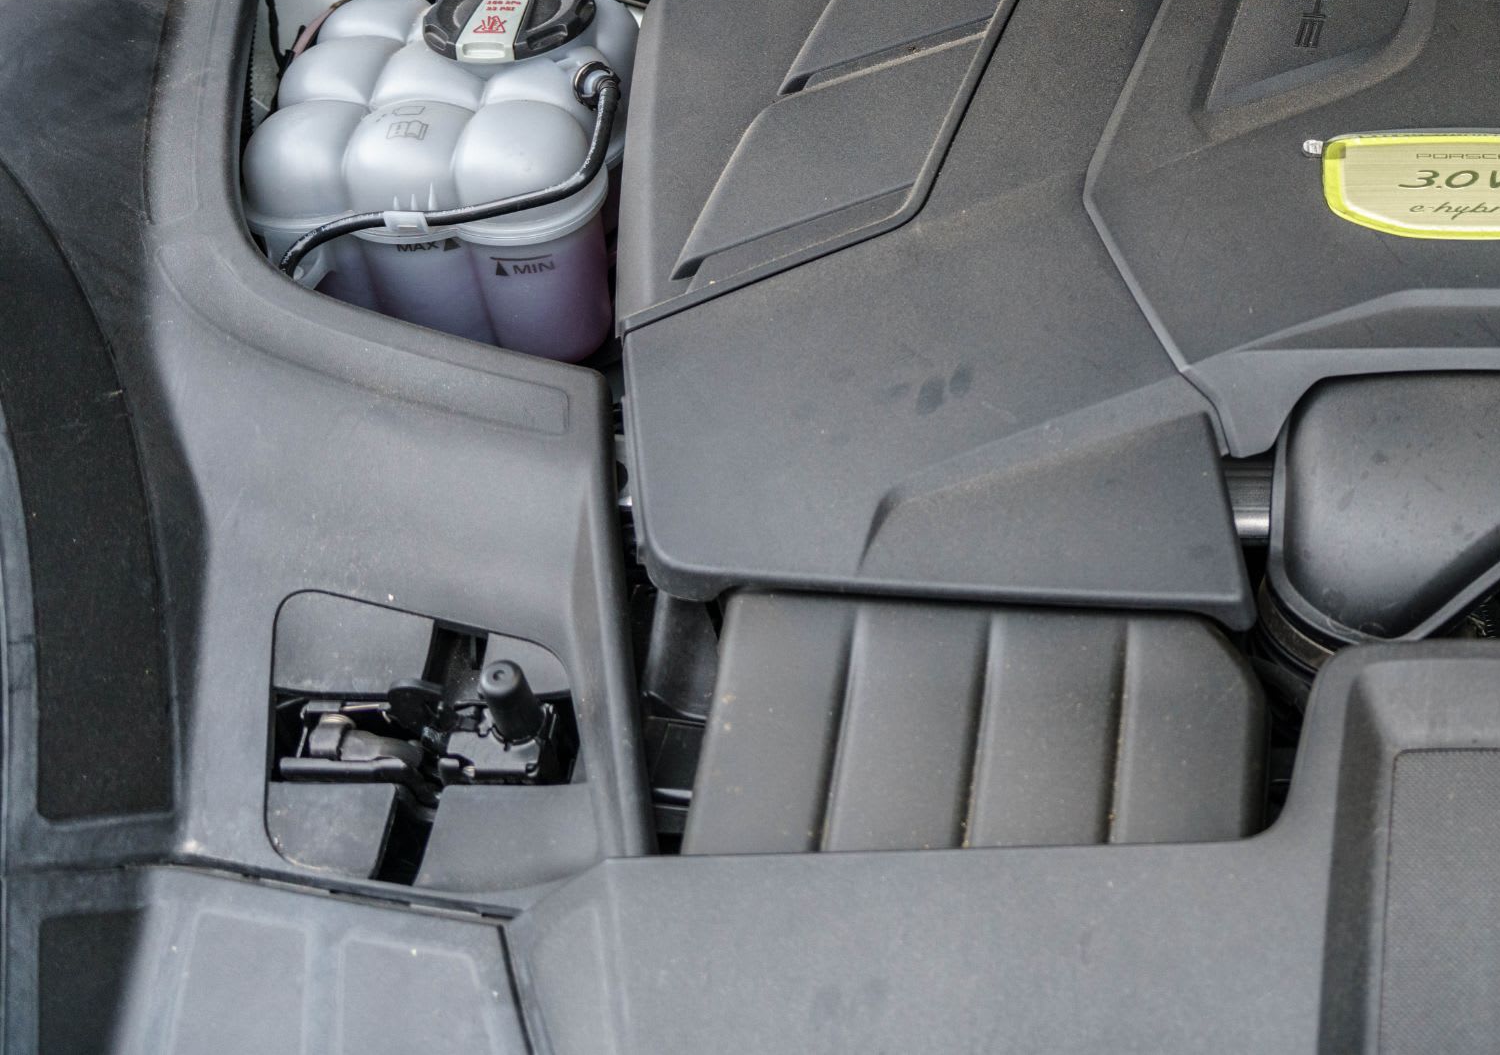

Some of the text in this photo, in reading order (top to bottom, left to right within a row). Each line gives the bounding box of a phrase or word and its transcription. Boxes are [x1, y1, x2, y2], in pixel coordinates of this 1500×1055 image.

[1398, 169, 1479, 189] 3.0
[396, 240, 440, 253] MAX
[511, 261, 557, 275] MIN
